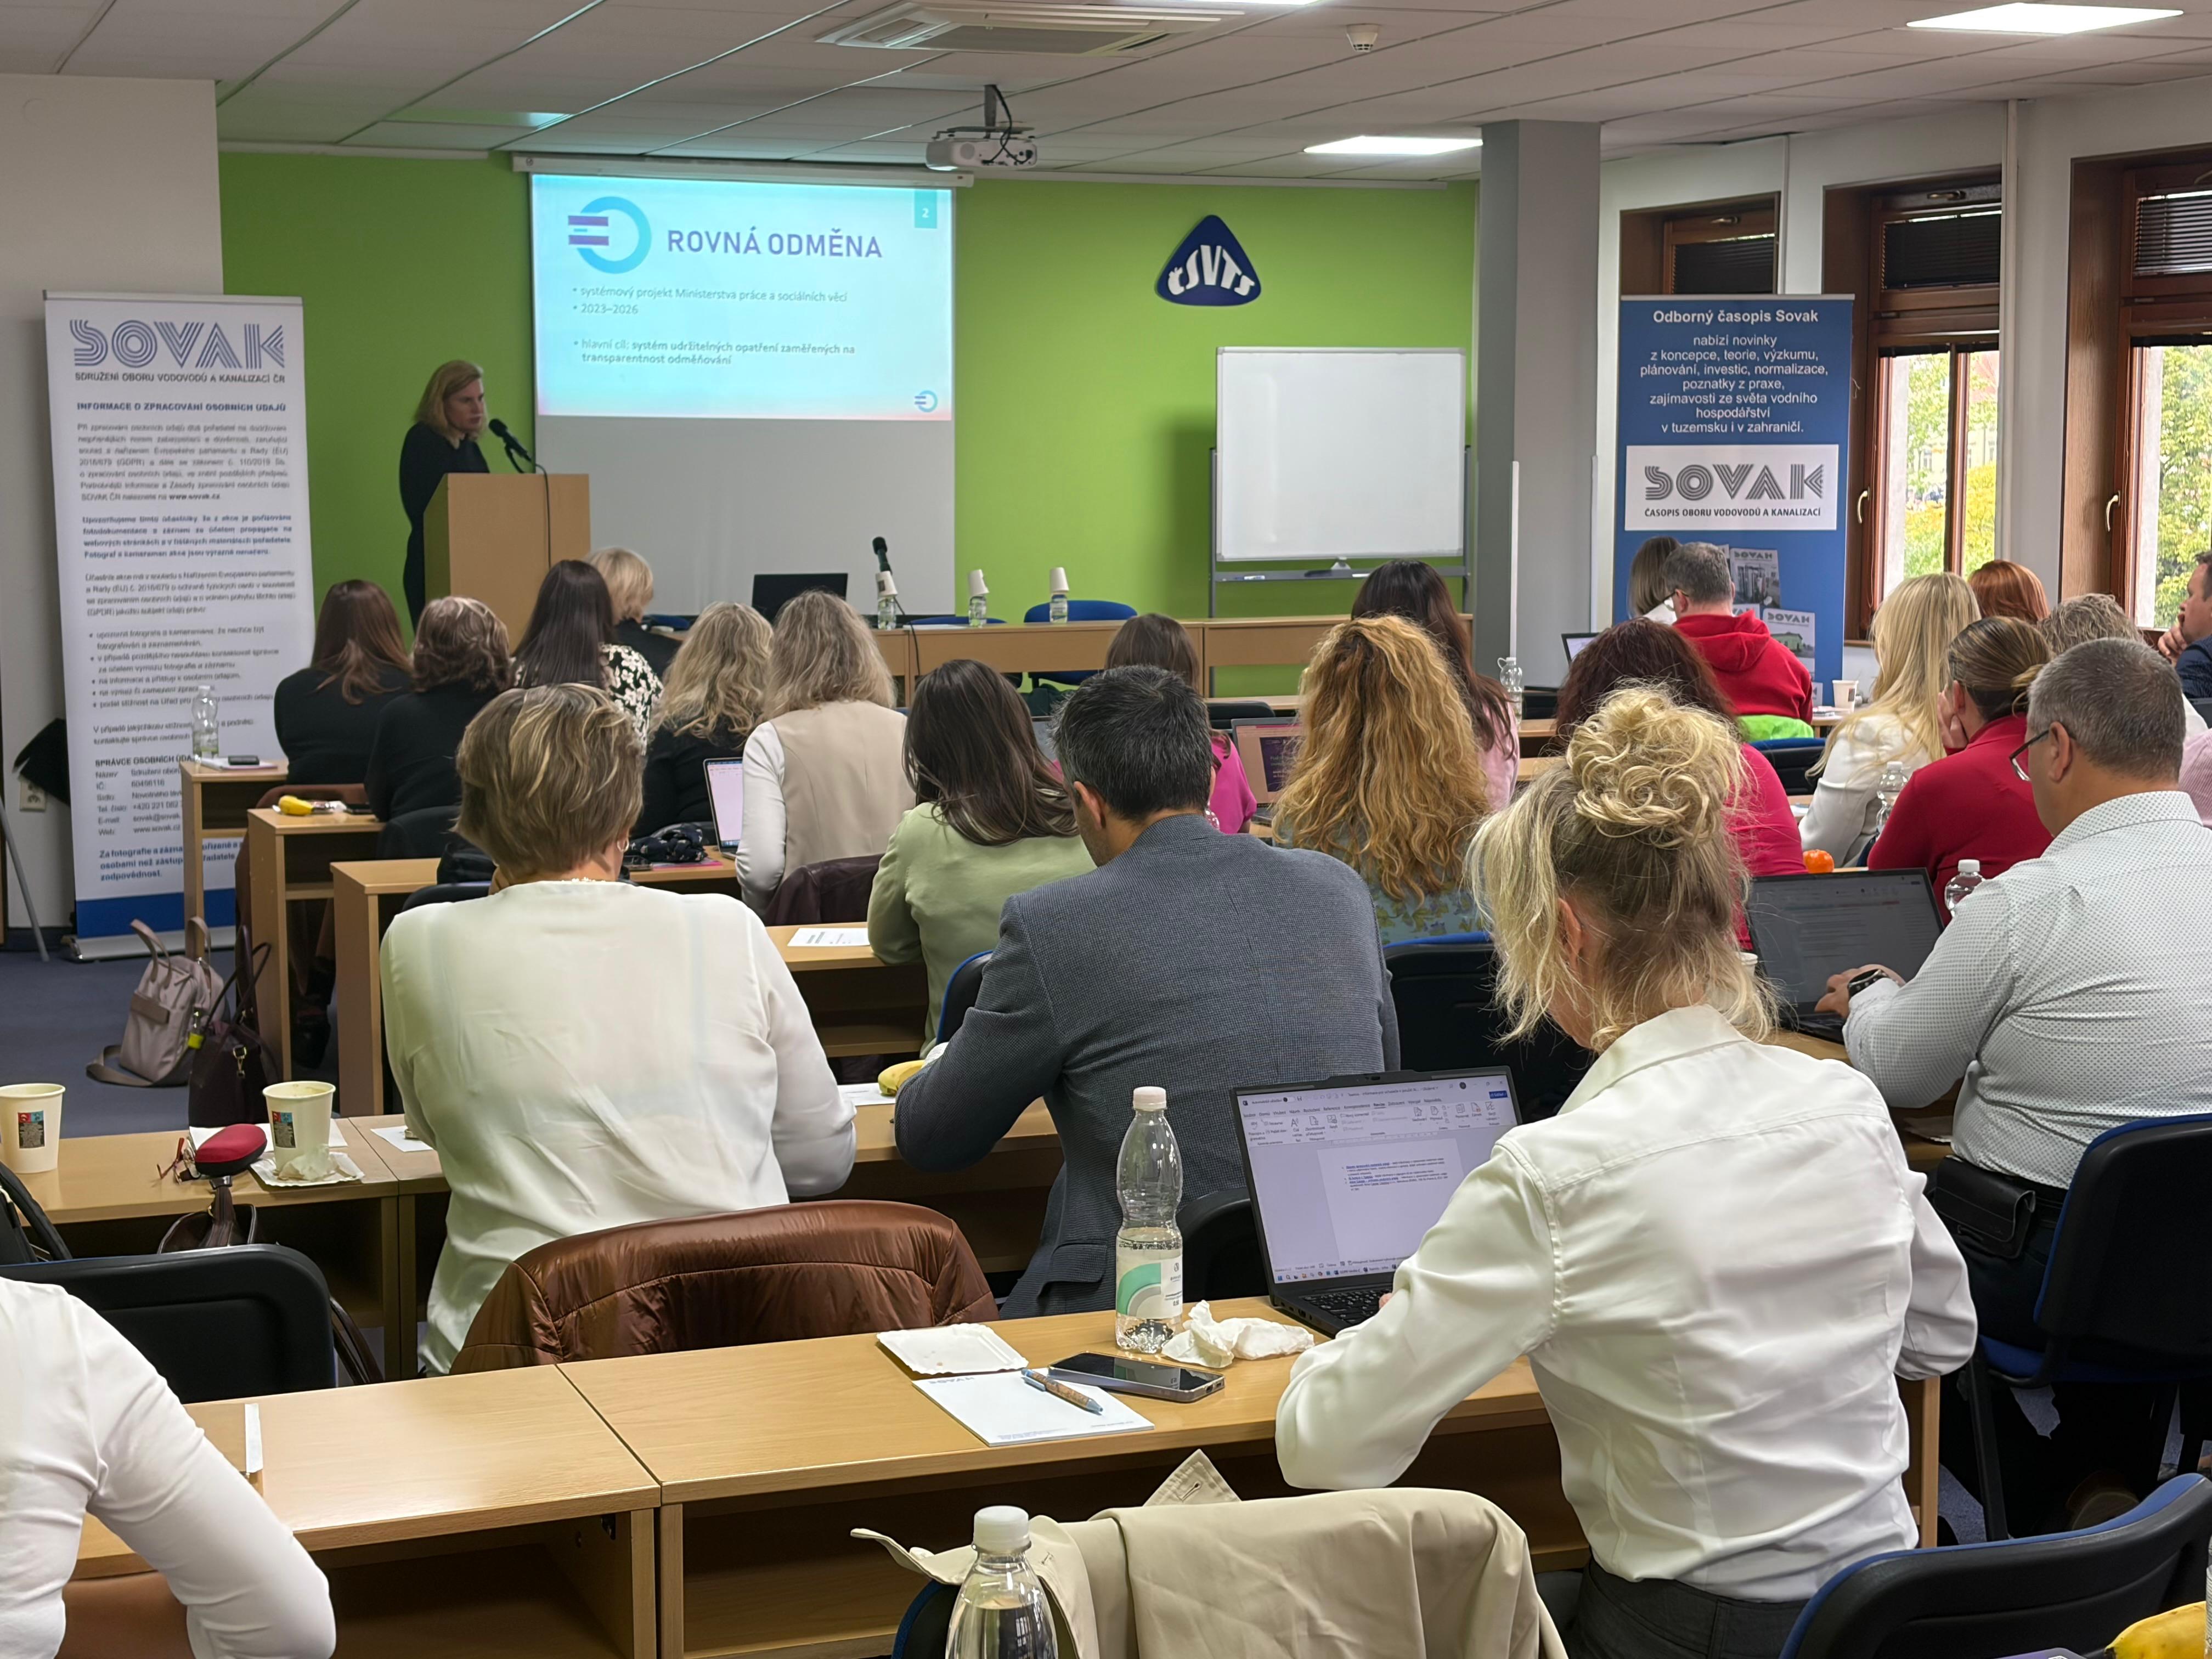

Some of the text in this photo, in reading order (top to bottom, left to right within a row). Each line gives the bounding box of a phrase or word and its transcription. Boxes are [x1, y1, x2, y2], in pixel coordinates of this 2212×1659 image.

[921, 207, 929, 218] 2
[668, 226, 883, 258] ROVNÁ ODMĚNA
[580, 286, 634, 300] systémový
[636, 287, 673, 301] projekt
[675, 288, 736, 300] Ministerstva
[738, 290, 767, 302] práce
[777, 290, 826, 301] sociálních
[828, 291, 847, 302] věcí
[1653, 310, 1818, 325] Odborný časopis Sovak
[70, 319, 285, 370] SOVAK
[582, 340, 612, 349] hlavní
[632, 340, 668, 353] systém
[670, 341, 733, 354] udržitelných
[735, 342, 778, 354] opatření
[780, 342, 840, 356] zaměřených
[1693, 334, 1778, 348] nabízí novinky
[582, 352, 731, 366] transparentnost odměňování
[1650, 348, 1819, 363] z koncepce, teorie, výzkumu,
[75, 371, 120, 381] SDRUŽENÍ
[122, 374, 154, 382] OBORU
[156, 373, 207, 382] VODOVODŮ
[219, 373, 270, 383] KANALIZACÍ
[272, 374, 285, 383] ČR
[1640, 363, 1828, 377] plánování, investic, normalizace,
[1683, 378, 1785, 392] poznatky z praxe,
[1649, 392, 1818, 407] zajímavosti ze světa vodního
[144, 402, 202, 411] ZPRACOVÁNÍ
[205, 402, 253, 412] OSOBNÍCH
[1696, 407, 1770, 420] hospodářství
[1661, 421, 1804, 432] v tuzemsku i v zahraničí.
[1644, 464, 1824, 501] SOVAK
[1644, 507, 1680, 517] ČASOPIS
[1714, 507, 1761, 517] VODOVODŮ
[1771, 507, 1821, 516] KANALIZACÍ
[133, 755, 174, 764] OSOBNÍCH
[176, 753, 191, 762] ÚDA
[133, 811, 180, 821] sovak@sovak
[99, 850, 110, 859] Za
[111, 847, 151, 859] fotografie
[159, 844, 183, 854] zázna
[202, 840, 231, 850] ořízené
[202, 851, 235, 861] řadatele
[100, 860, 136, 870] osobami
[138, 859, 153, 867] než
